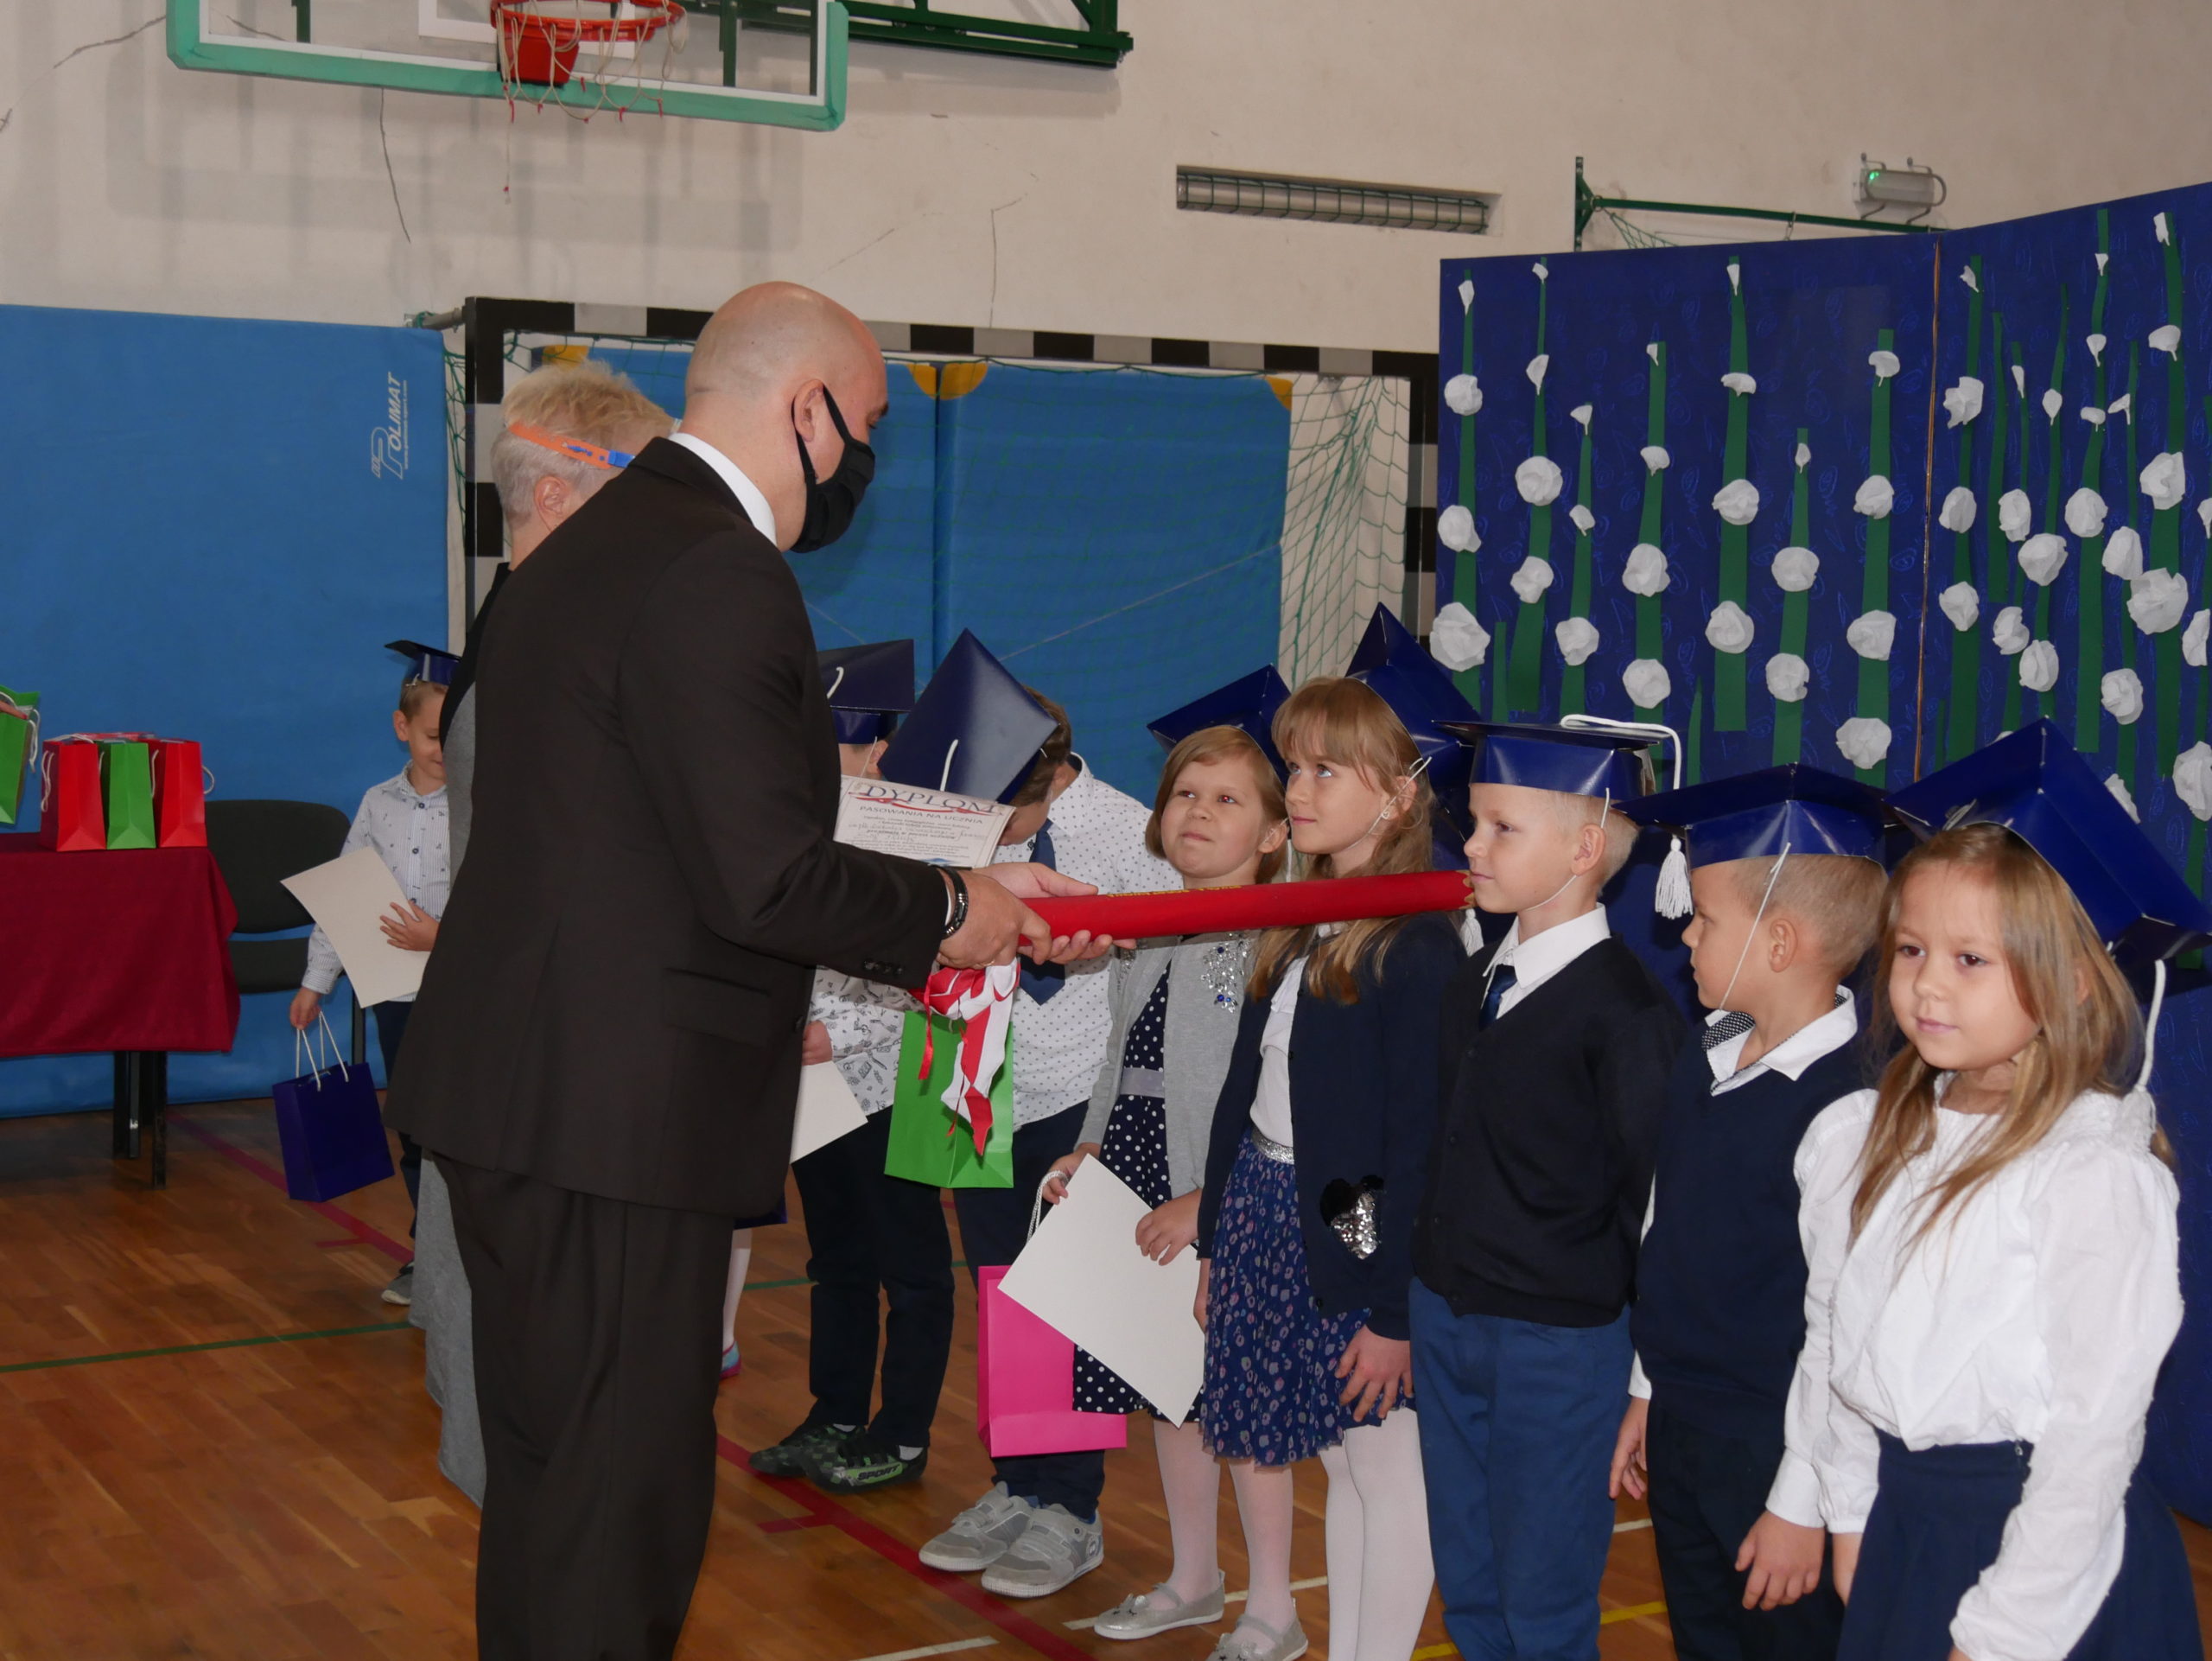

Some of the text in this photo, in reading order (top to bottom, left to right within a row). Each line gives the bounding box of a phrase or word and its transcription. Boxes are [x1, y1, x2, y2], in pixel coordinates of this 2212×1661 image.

[372, 371, 403, 479] POLIMAT
[859, 805, 923, 817] PASOWANIA
[866, 785, 999, 815] DYPLOM
[857, 1464, 900, 1480] SPORT
